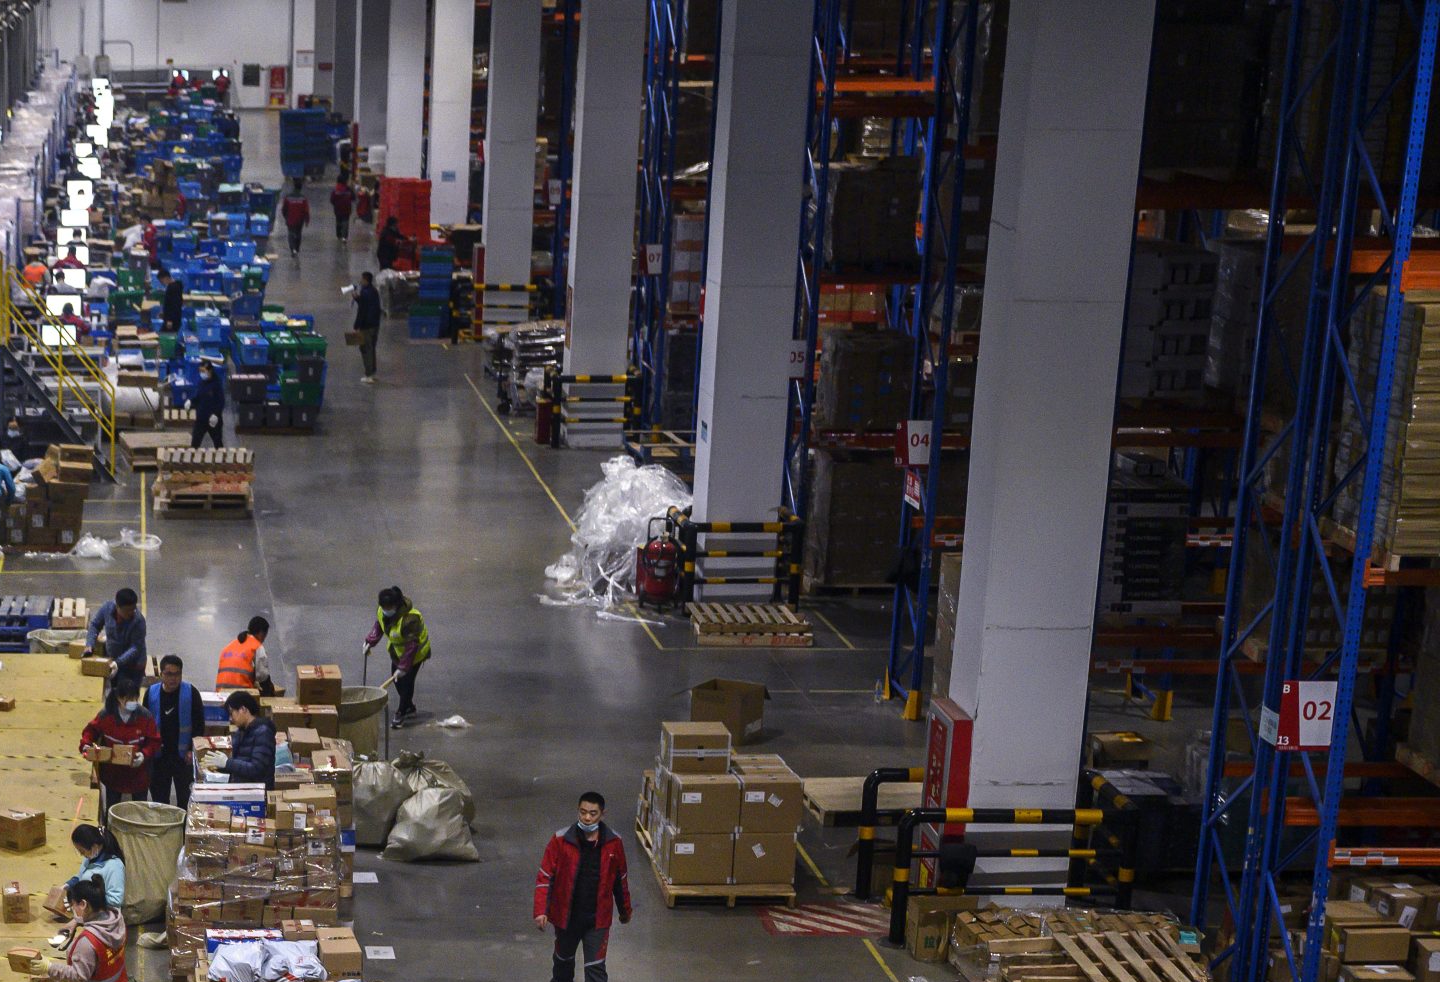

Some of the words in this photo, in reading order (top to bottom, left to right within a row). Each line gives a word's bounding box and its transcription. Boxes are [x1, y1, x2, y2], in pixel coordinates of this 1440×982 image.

[910, 433, 930, 448] 04
[1282, 684, 1291, 694] B
[1302, 701, 1332, 721] 02
[1277, 736, 1290, 746] 13
